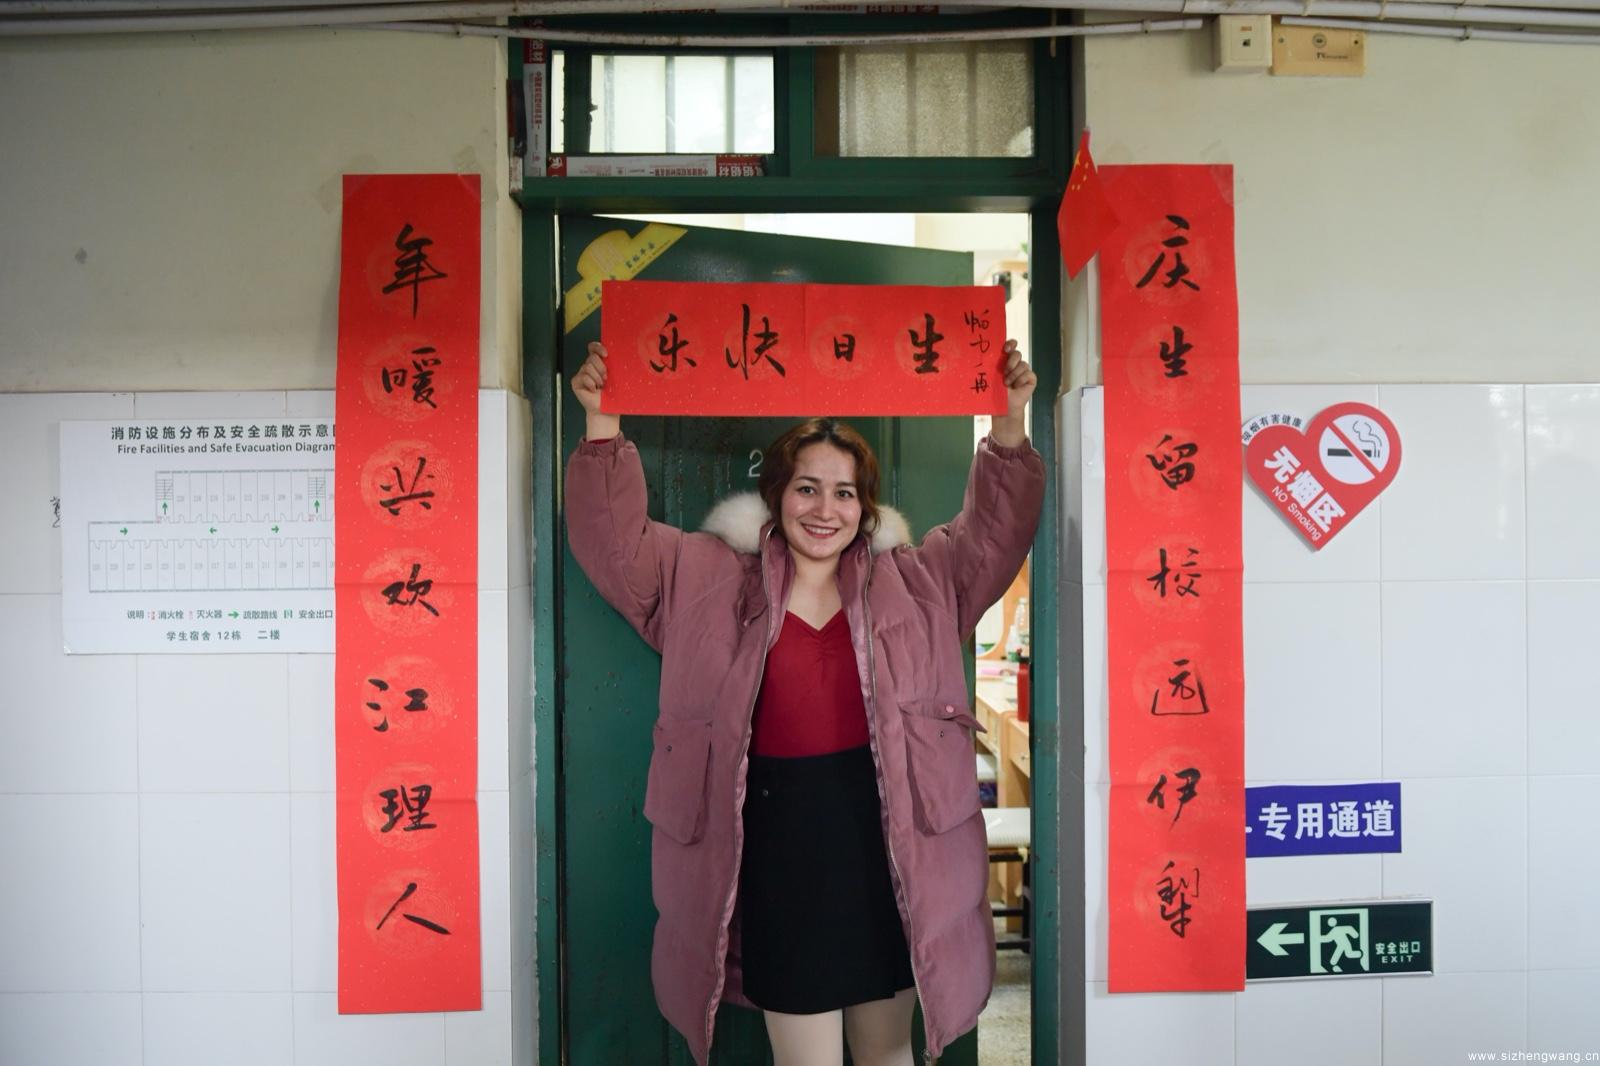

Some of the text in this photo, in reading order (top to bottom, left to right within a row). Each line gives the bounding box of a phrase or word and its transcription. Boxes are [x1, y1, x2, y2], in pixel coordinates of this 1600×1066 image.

[111, 423, 335, 440] 消防设施分布及安全疏散示意
[117, 444, 137, 454] Fire
[140, 443, 185, 454] Facilities
[188, 443, 207, 453] and
[210, 443, 233, 453] Safe
[235, 442, 292, 453] Evacuation
[1264, 446, 1346, 534] 无烟区
[1271, 486, 1322, 542] NO Smoking
[158, 610, 184, 620] 消火栓
[299, 609, 334, 620] 安全出口
[166, 630, 281, 642] 学生宿舍 12栋 二楼
[1375, 941, 1421, 955] 安全出口
[1381, 954, 1414, 964] EXIT
